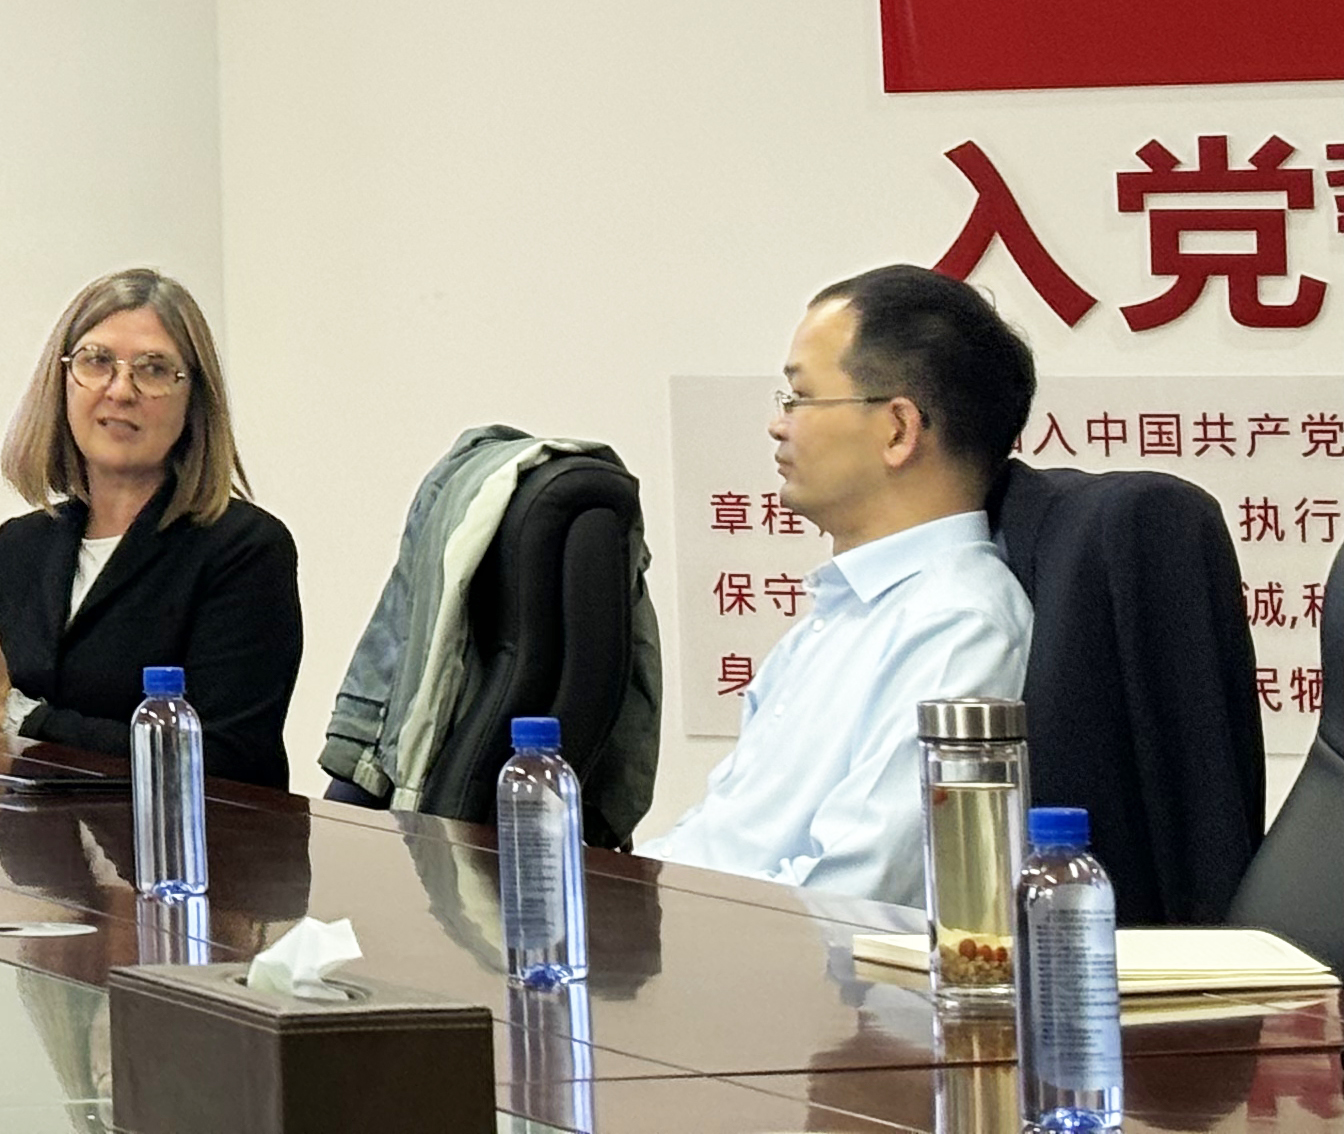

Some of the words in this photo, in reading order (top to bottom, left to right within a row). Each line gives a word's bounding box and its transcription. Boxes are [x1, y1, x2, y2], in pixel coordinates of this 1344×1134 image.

[926, 134, 1344, 332] 入党
[1014, 412, 1344, 457] 入中国共产党
[1238, 496, 1341, 542] 执行
[713, 572, 807, 617] 保守
